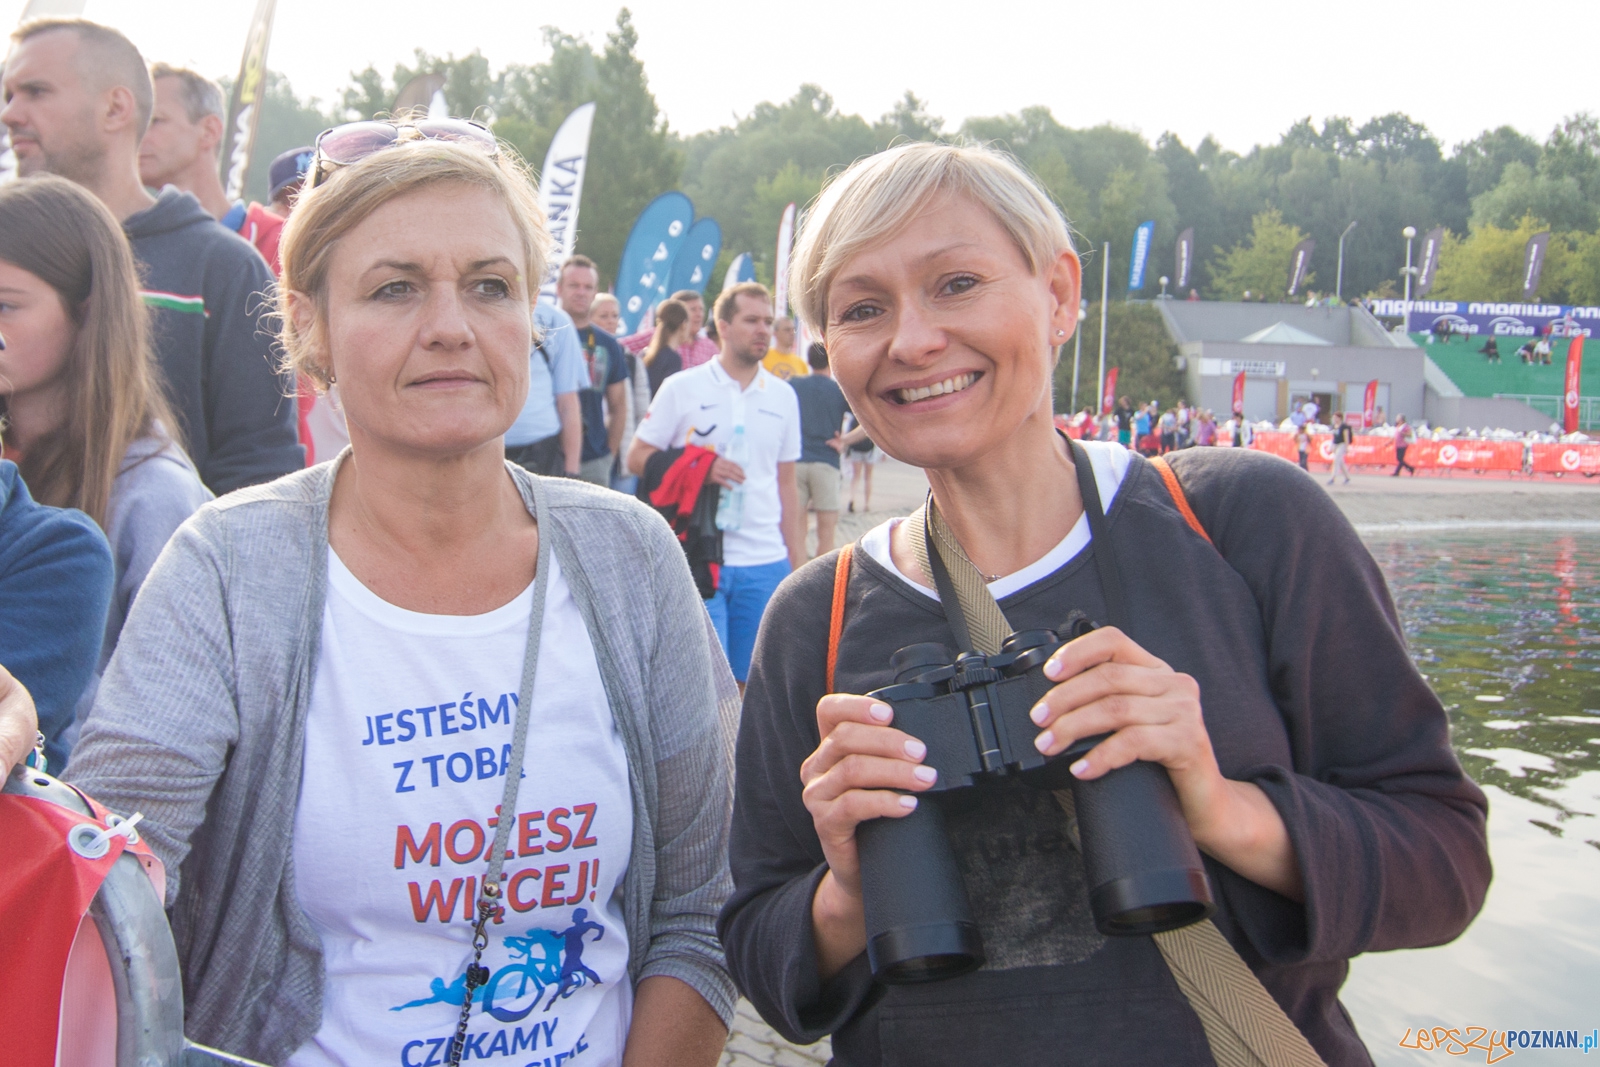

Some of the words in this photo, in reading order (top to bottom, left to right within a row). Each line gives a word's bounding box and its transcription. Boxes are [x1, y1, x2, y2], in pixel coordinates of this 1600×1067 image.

[1445, 321, 1479, 334] nea
[1494, 322, 1535, 335] Enea
[393, 760, 415, 793] Z
[394, 802, 598, 869] MOŻESZ
